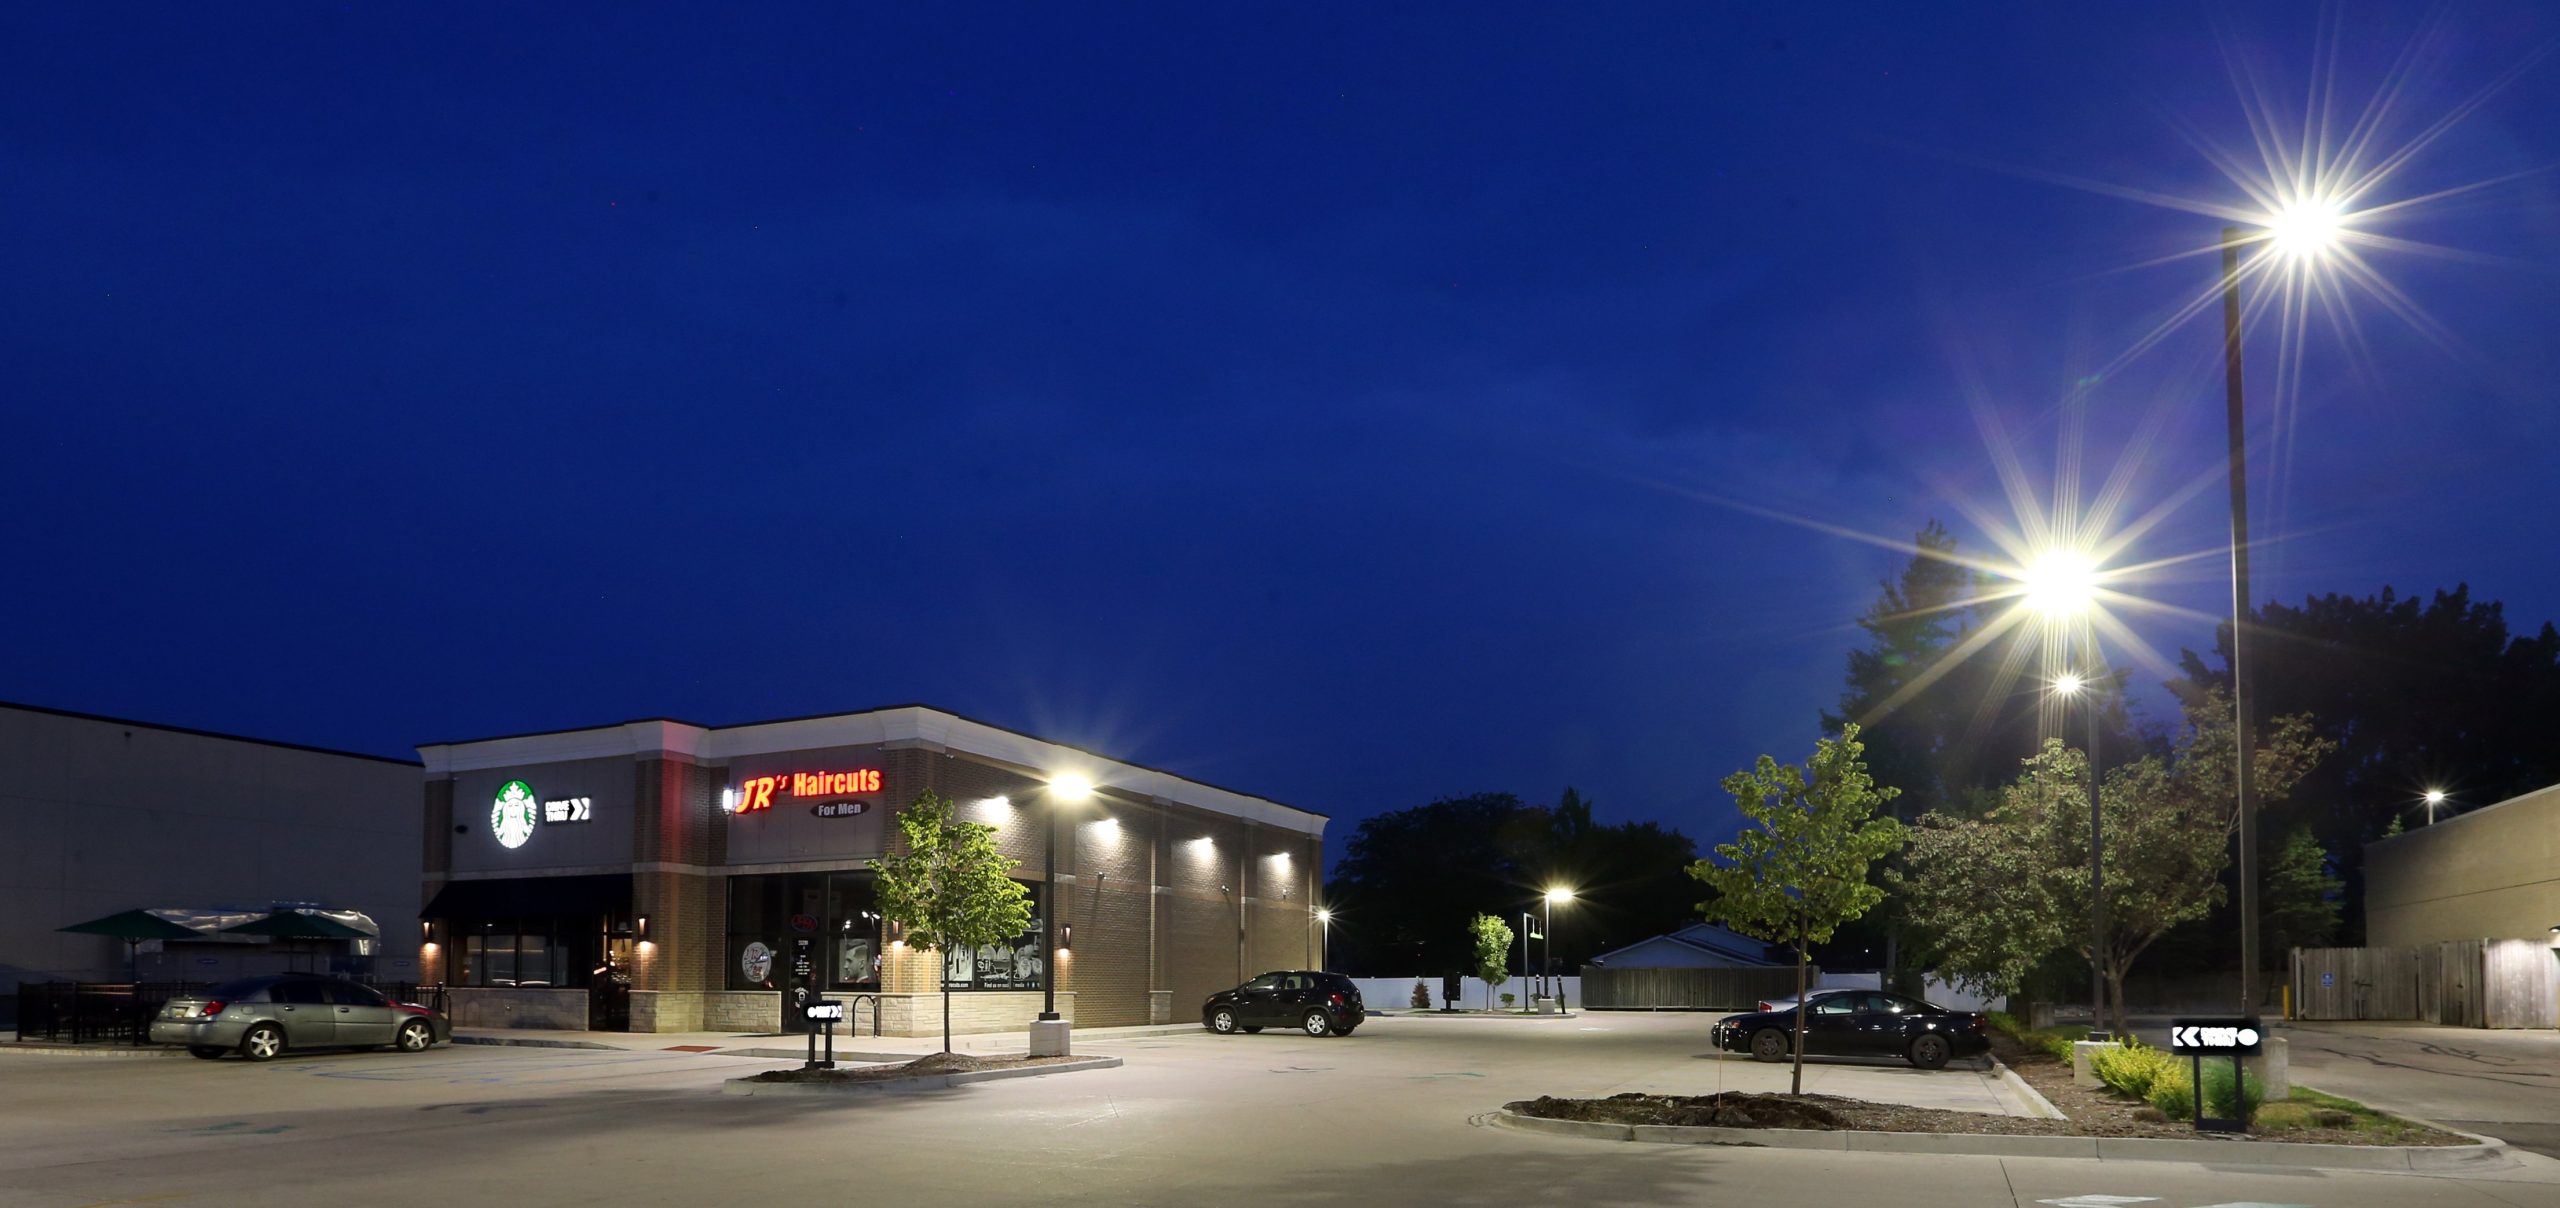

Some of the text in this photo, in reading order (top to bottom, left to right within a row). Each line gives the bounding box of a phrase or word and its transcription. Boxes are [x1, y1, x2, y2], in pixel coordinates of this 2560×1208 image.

[735, 768, 882, 814] JR's Haircuts
[818, 803, 861, 816] For Men
